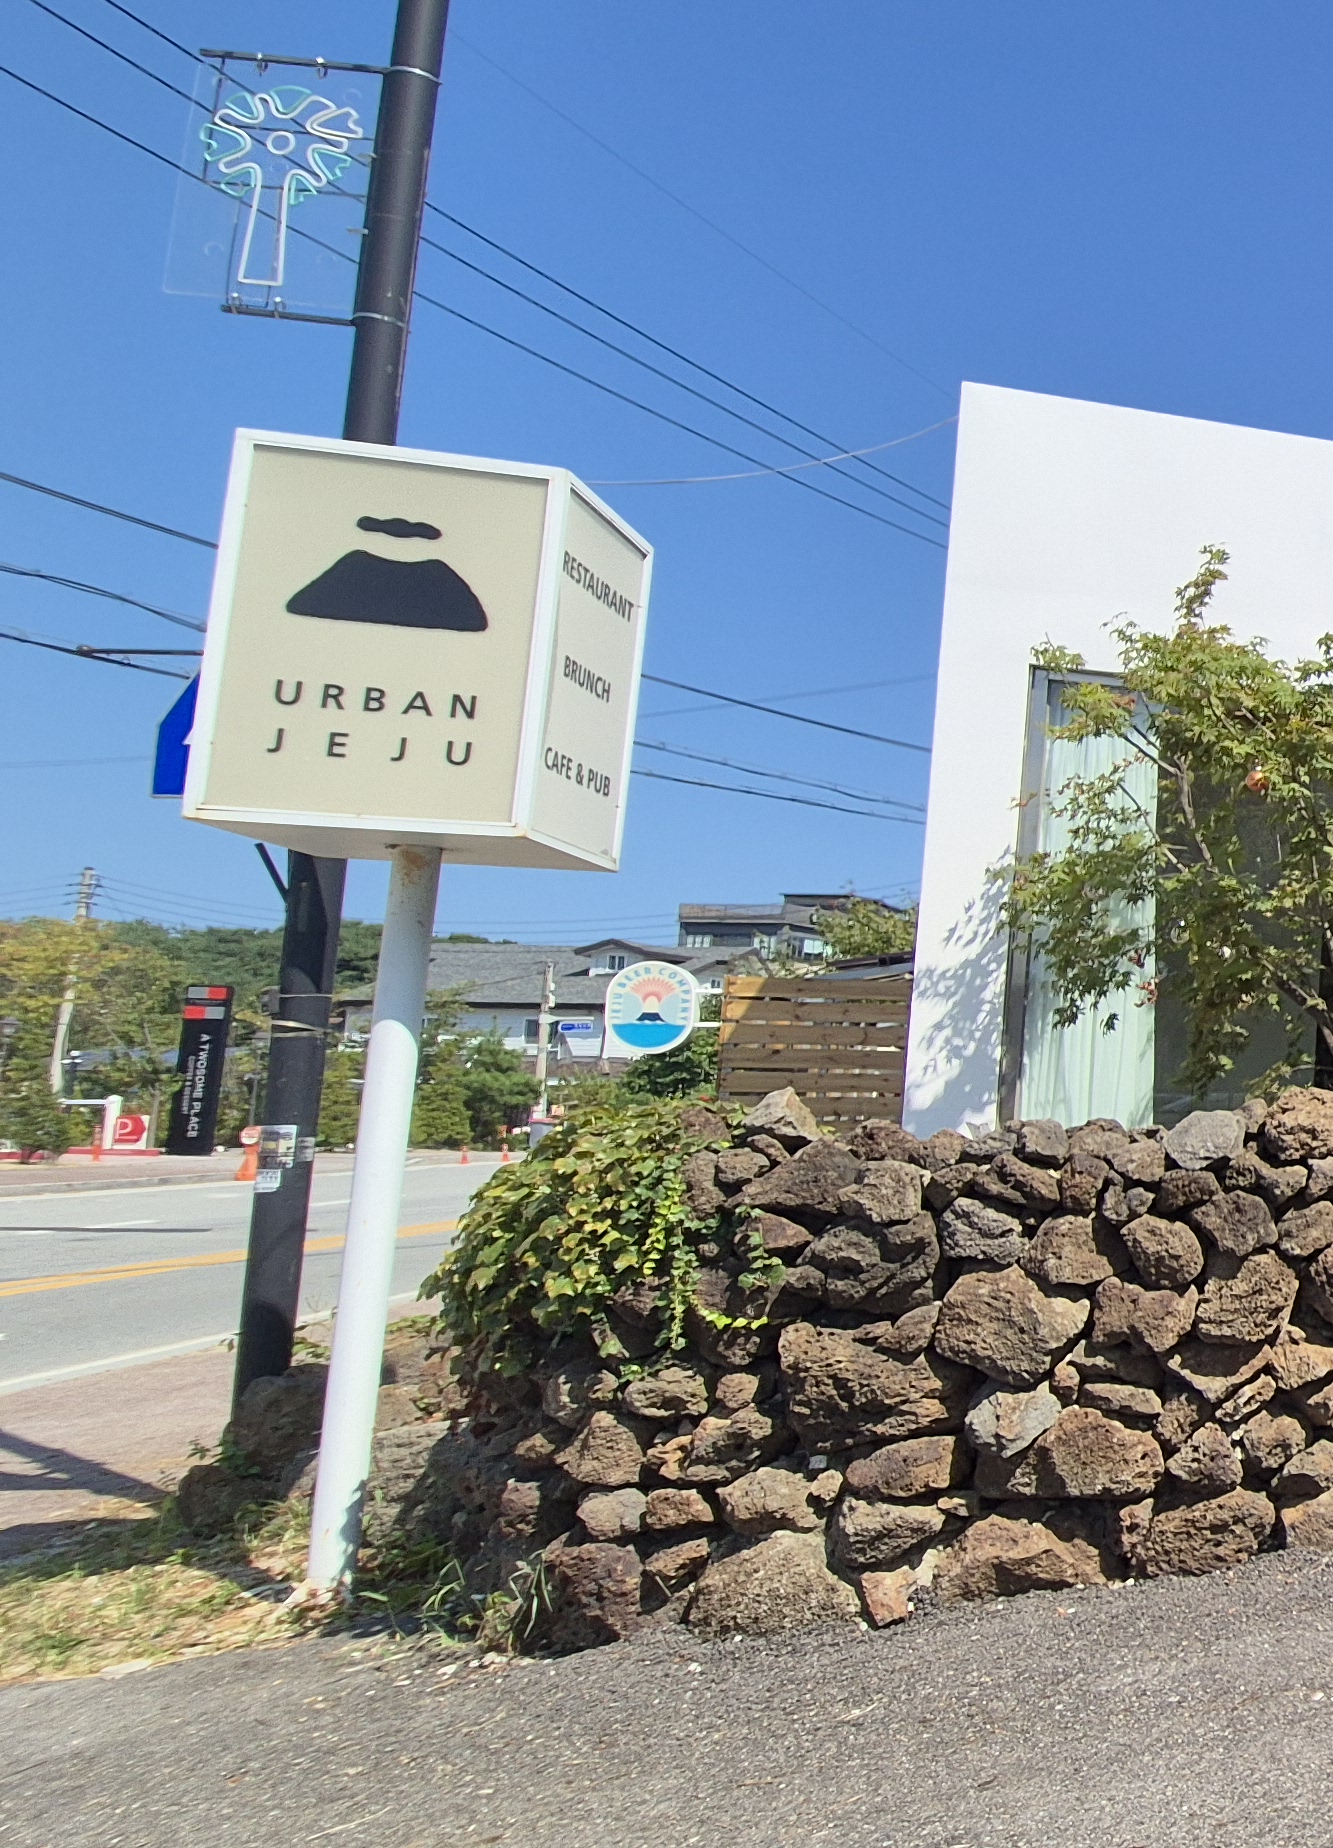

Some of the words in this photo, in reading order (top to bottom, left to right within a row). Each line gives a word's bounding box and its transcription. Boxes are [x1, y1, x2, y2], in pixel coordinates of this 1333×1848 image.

[562, 550, 634, 622] RESTAURANT
[563, 654, 611, 703] BRUNCH
[274, 679, 477, 720] URBAN
[266, 727, 473, 766] JEJU
[544, 746, 572, 781] CAFE
[575, 762, 584, 786] &
[587, 767, 611, 797] PUB
[617, 966, 652, 988] BEER
[200, 1033, 211, 1042] A
